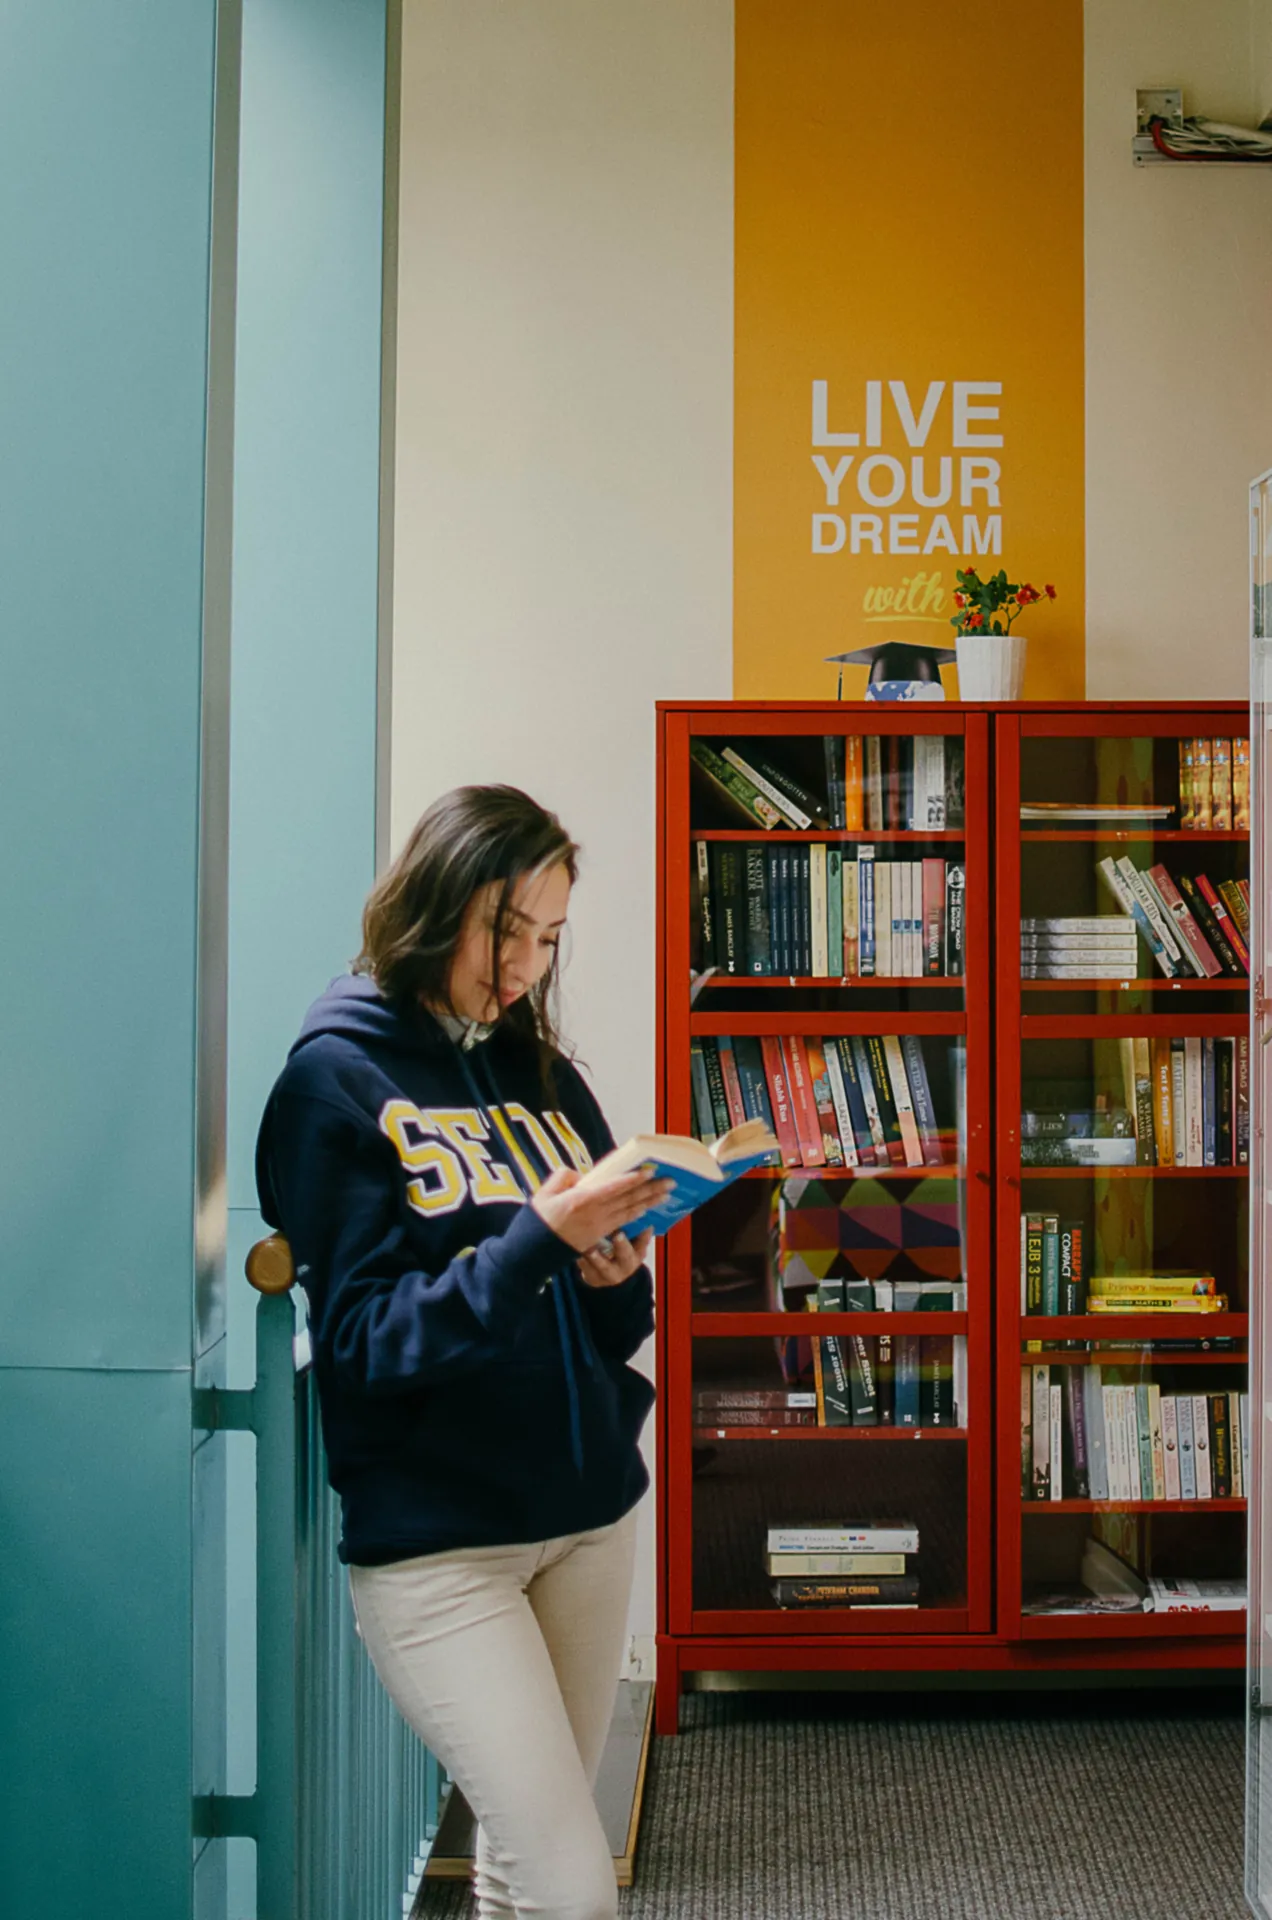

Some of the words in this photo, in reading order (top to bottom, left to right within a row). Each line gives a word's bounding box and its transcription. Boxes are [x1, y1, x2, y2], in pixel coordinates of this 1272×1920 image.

[812, 380, 1004, 447] LIVE
[811, 454, 1003, 508] YOUR
[812, 513, 1003, 555] DREAM
[862, 571, 948, 614] with
[928, 923, 939, 958] MONSOON
[1160, 1065, 1168, 1084] Text
[1239, 1059, 1248, 1089] HOAG
[1028, 1238, 1042, 1262] EJB
[1062, 1233, 1071, 1278] COMPACT
[1071, 1229, 1082, 1282] HARRAP'S
[1028, 1266, 1041, 1275] 3
[1108, 1282, 1146, 1293] Primary
[861, 1359, 876, 1397] Street
